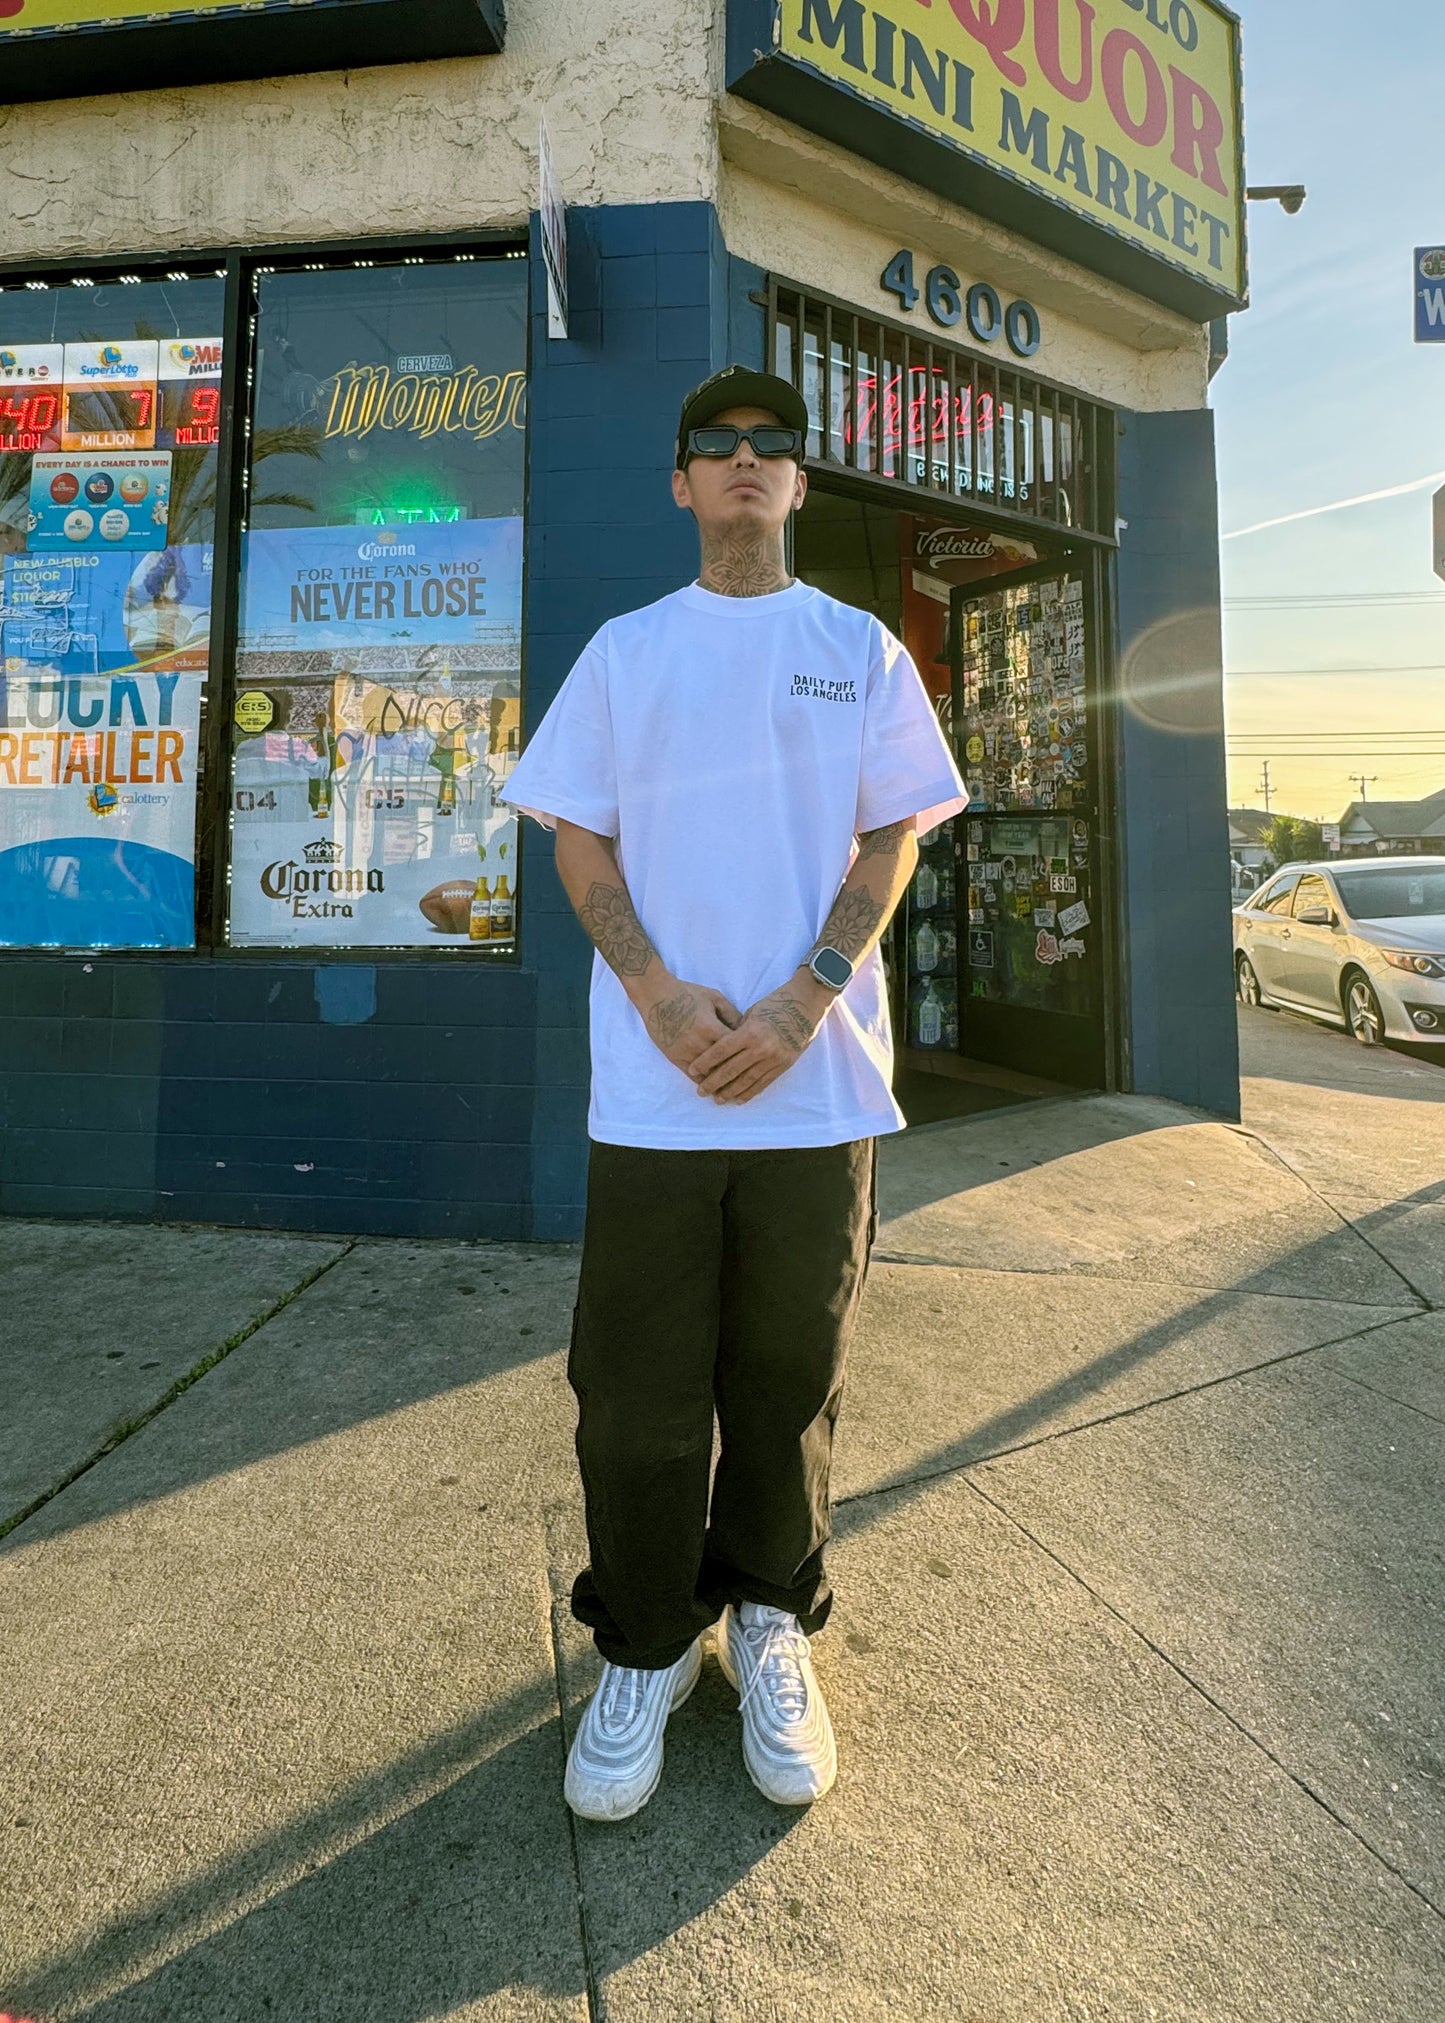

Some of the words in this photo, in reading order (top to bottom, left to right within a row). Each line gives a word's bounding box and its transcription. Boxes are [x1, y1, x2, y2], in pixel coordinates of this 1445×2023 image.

[1121, 0, 1198, 52] LO
[917, 0, 1228, 197] QUOR
[797, 0, 976, 132] MINI
[998, 86, 1230, 271] MARKET
[880, 247, 1041, 358] 4600
[0, 367, 36, 378] WER
[80, 365, 139, 378] SuperLotto
[397, 354, 453, 373] CERVEZA
[0, 395, 58, 433] 40
[130, 390, 152, 428] 7
[81, 434, 136, 448] MILLION
[36, 461, 64, 469] EVERY
[93, 460, 100, 468] A
[138, 459, 150, 467] TO
[152, 459, 169, 467] WIN
[357, 541, 416, 561] Corona
[916, 527, 996, 568] Victoria
[14, 559, 44, 569] NEW
[48, 556, 99, 569] PUEBLO
[297, 568, 333, 582] FOR
[340, 566, 376, 579] THE
[384, 563, 433, 578] FANS
[439, 561, 480, 576] WHO
[13, 571, 61, 584] LIQUOR
[290, 580, 395, 623] NEVER
[404, 576, 487, 617] LOSE
[790, 685, 810, 696] LOS
[812, 688, 857, 703] ANGELES
[794, 674, 826, 689] DAILY
[828, 680, 855, 692] PUFF
[0, 672, 181, 729] LUCKY
[0, 731, 185, 785] RETAILER
[122, 792, 170, 806] calottery
[236, 789, 277, 811] 04
[260, 860, 386, 904] Corona
[292, 895, 355, 919] Extra
